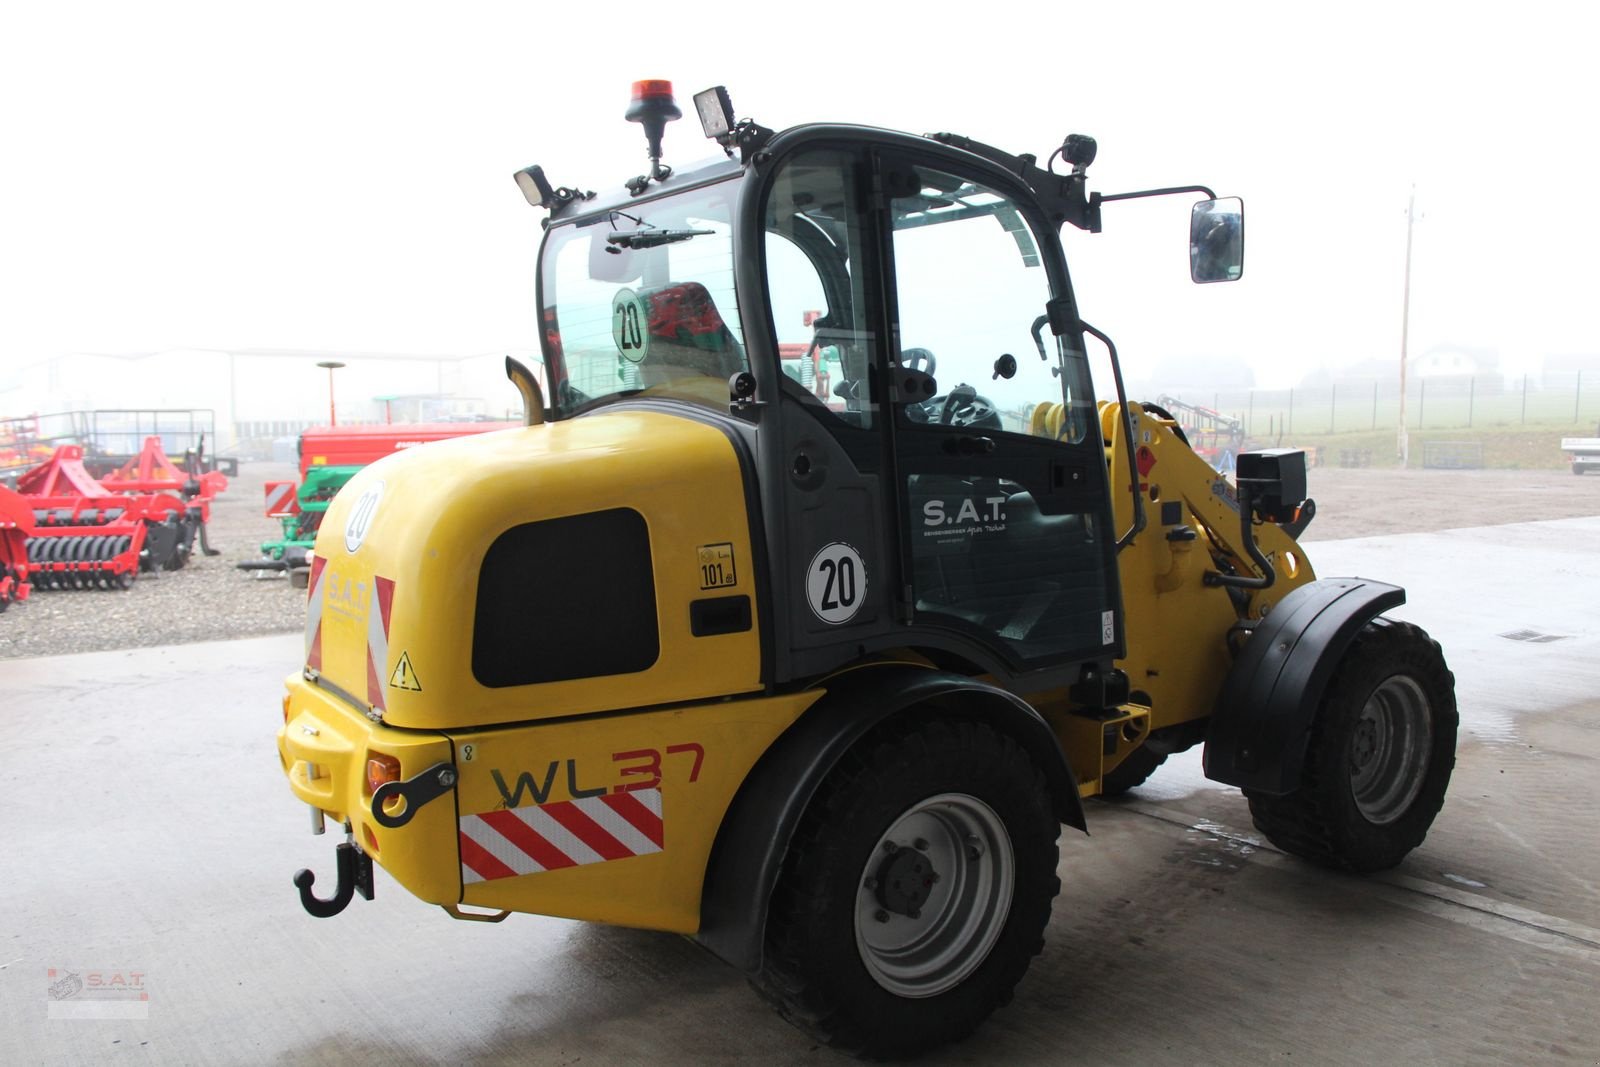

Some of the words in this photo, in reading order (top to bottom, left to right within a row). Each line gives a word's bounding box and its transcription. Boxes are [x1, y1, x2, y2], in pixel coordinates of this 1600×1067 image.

[616, 302, 642, 350] 20
[347, 491, 379, 540] 20
[923, 497, 1006, 526] S.A.T.
[701, 563, 724, 586] 101
[819, 556, 856, 611] 20
